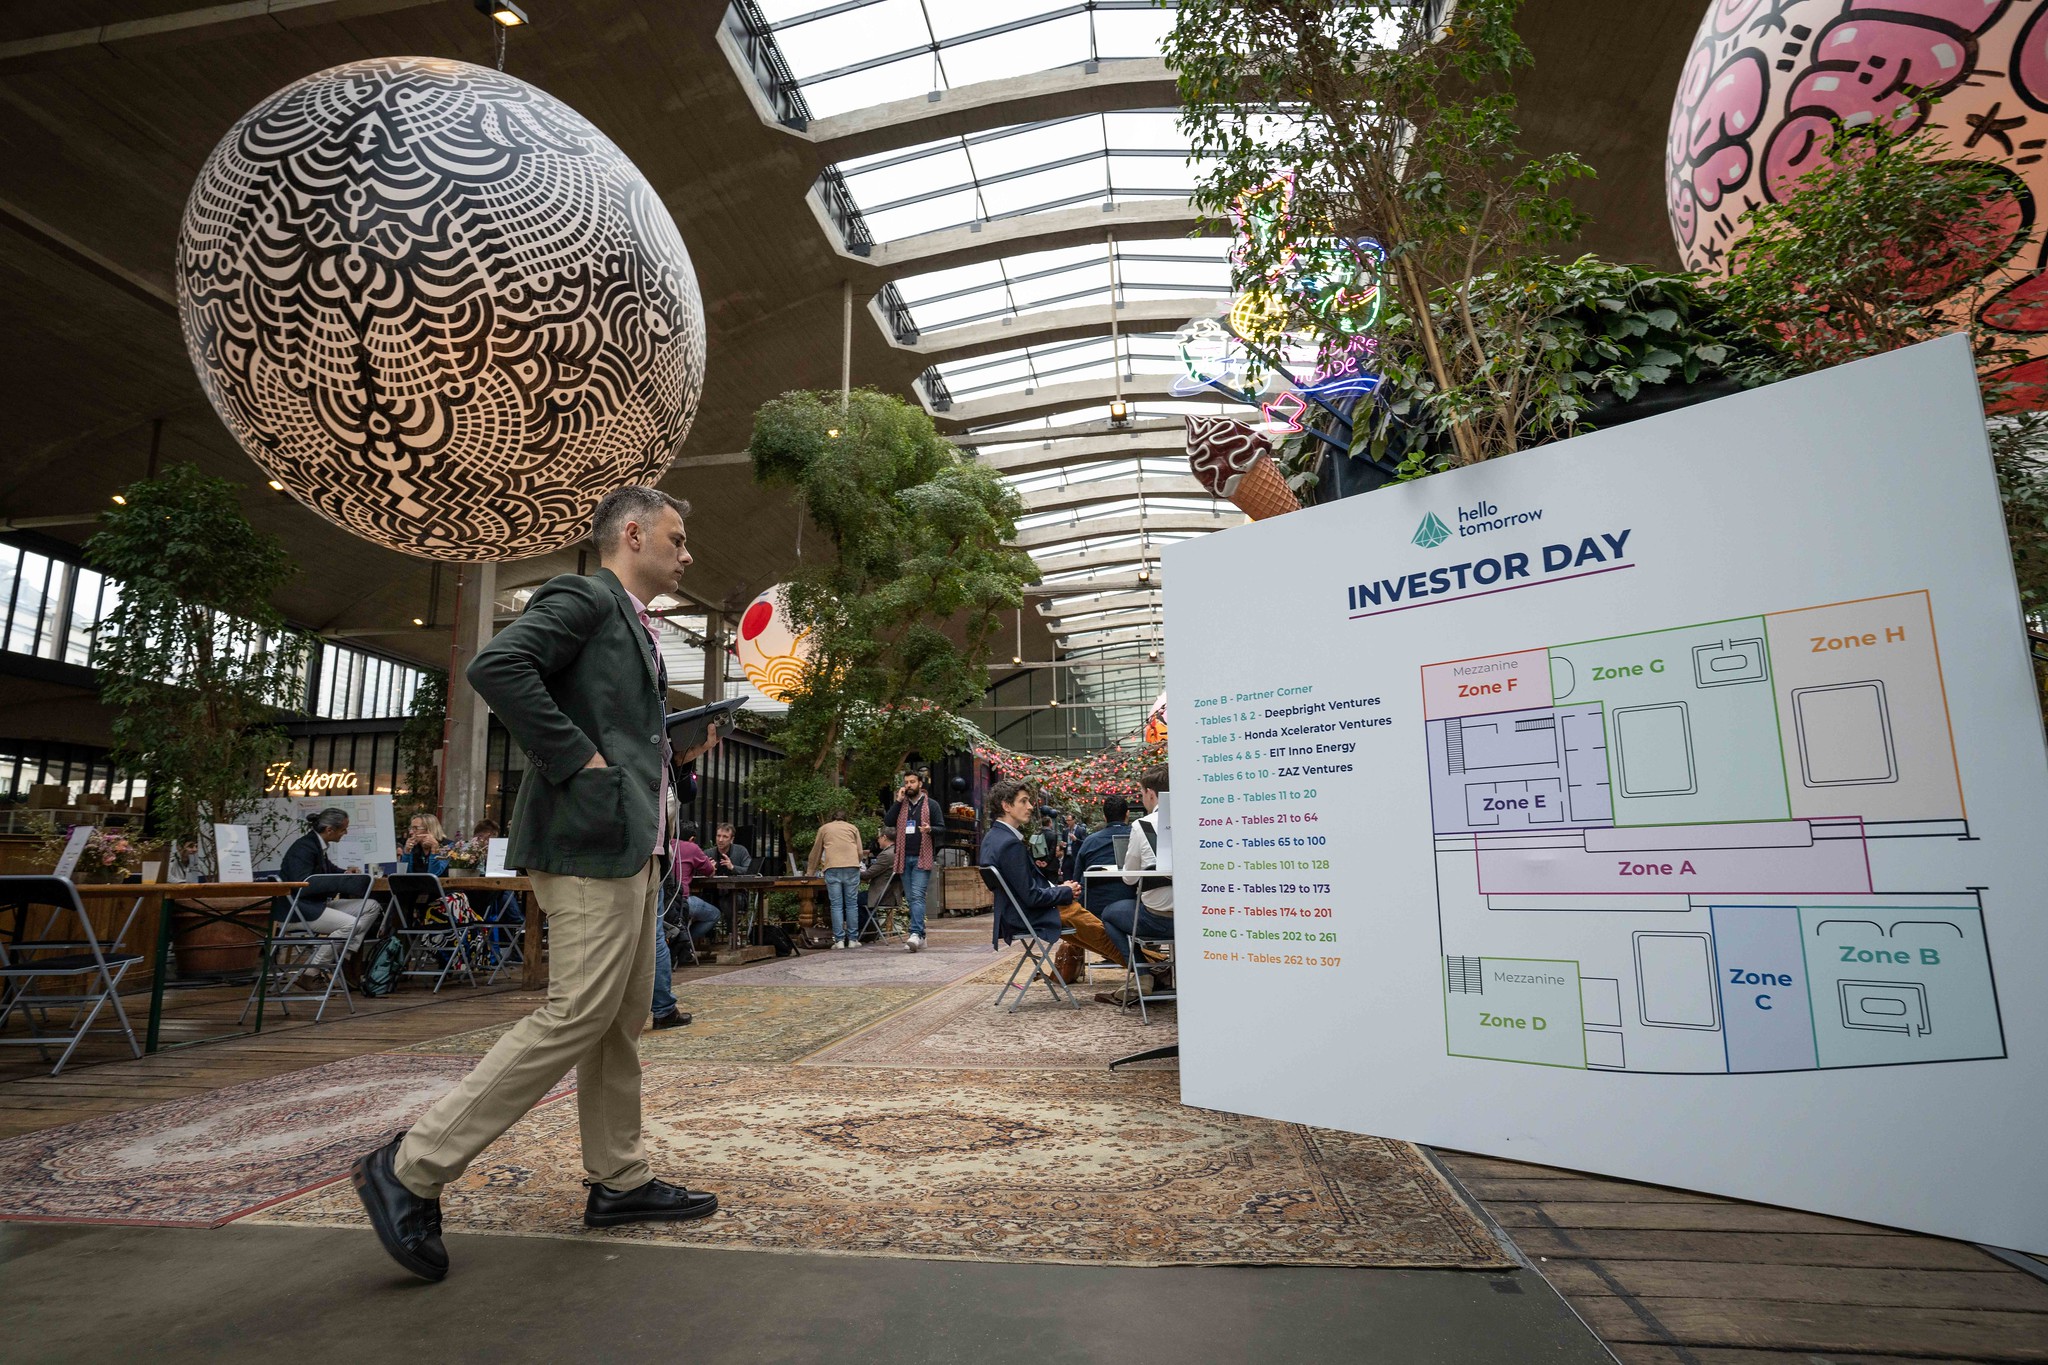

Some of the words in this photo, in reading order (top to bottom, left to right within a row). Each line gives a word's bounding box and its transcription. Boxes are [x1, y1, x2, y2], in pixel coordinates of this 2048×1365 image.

[1458, 501, 1498, 523] hello
[1459, 509, 1543, 537] tomorrow
[1348, 552, 1530, 611] INVESTOR
[1542, 529, 1631, 573] DAY
[1810, 634, 1877, 652] Zone
[1886, 626, 1905, 643] H
[1453, 660, 1519, 677] Mezzanine
[1592, 664, 1643, 682] Zone
[1650, 659, 1665, 674] G
[1193, 698, 1219, 709] Zone
[1220, 695, 1228, 705] B
[1235, 690, 1275, 703] Partner
[1276, 685, 1314, 697] Corner
[1458, 682, 1502, 699] Zone
[1507, 678, 1518, 692] F
[1199, 714, 1232, 726] Tables
[1233, 713, 1238, 722] 1
[1240, 711, 1248, 722] &
[1249, 710, 1256, 721] 2
[1264, 702, 1327, 719] Deepbright
[1327, 696, 1381, 711] Ventures
[1200, 733, 1228, 745] Table
[1229, 732, 1236, 742] 3
[1244, 727, 1279, 741] Honda
[1280, 723, 1337, 737] Xcelerator
[1338, 716, 1393, 731] Ventures
[1201, 752, 1234, 764] Tables
[1235, 751, 1243, 761] 4
[1244, 750, 1253, 761] &
[1254, 749, 1261, 760] 5
[1269, 747, 1287, 758] EIT
[1288, 745, 1314, 757] Inno
[1315, 742, 1357, 755] Energy
[265, 761, 358, 792] Trattoria
[1202, 772, 1235, 783] Tables
[1236, 770, 1244, 781] 6
[1244, 771, 1257, 780] to
[1257, 768, 1270, 779] 10
[1277, 766, 1301, 778] ZAZ
[1301, 762, 1354, 777] Ventures
[1200, 795, 1226, 805] Zone
[1227, 793, 1235, 804] B
[1242, 791, 1277, 803] Tables
[1278, 790, 1287, 801] 11
[1288, 790, 1302, 800] to
[1303, 788, 1318, 799] 20
[1483, 798, 1529, 811] Zone
[1535, 795, 1546, 808] E
[1198, 817, 1224, 827] Zone
[1224, 816, 1234, 826] A
[1240, 814, 1276, 825] Tables
[1276, 813, 1288, 825] 21
[1289, 813, 1302, 823] to
[1303, 812, 1319, 824] 64
[1198, 838, 1225, 850] Zone
[1225, 837, 1234, 849] C
[1241, 837, 1276, 849] Tables
[1277, 836, 1291, 848] 65
[1292, 836, 1305, 847] to
[1306, 834, 1327, 847] 100
[1199, 861, 1225, 871] Zone
[1226, 860, 1236, 871] D
[1243, 860, 1278, 871] Tables
[1279, 860, 1295, 870] 101
[1296, 860, 1310, 870] to
[1311, 859, 1330, 870] 128
[1618, 862, 1673, 875] Zone
[1680, 860, 1696, 875] A
[1200, 883, 1226, 893] Zone
[1227, 882, 1235, 893] E
[1242, 882, 1278, 894] Tables
[1278, 882, 1297, 894] 129
[1298, 884, 1311, 894] to
[1312, 882, 1331, 894] 173
[1200, 904, 1227, 916] Zone
[1228, 906, 1236, 916] F
[1243, 905, 1278, 918] Tables
[1279, 906, 1298, 918] 174
[1299, 908, 1313, 919] to
[1313, 907, 1333, 919] 201
[1202, 927, 1228, 939] Zone
[1229, 928, 1238, 939] G
[1245, 929, 1281, 941] Tables
[1281, 930, 1303, 942] 202
[1304, 932, 1317, 942] to
[1318, 931, 1337, 943] 261
[1202, 949, 1229, 961] Zone
[1229, 952, 1239, 962] H
[1246, 952, 1282, 965] Tables
[1283, 954, 1304, 966] 262
[1305, 956, 1318, 966] to
[1319, 956, 1342, 968] 307
[1839, 946, 1910, 964] Zone
[1920, 948, 1940, 965] B
[1494, 972, 1565, 986] Mezzanine
[1729, 969, 1792, 986] Zone
[1755, 994, 1772, 1010] C
[1480, 1013, 1526, 1029] Zone
[1532, 1017, 1547, 1030] D
